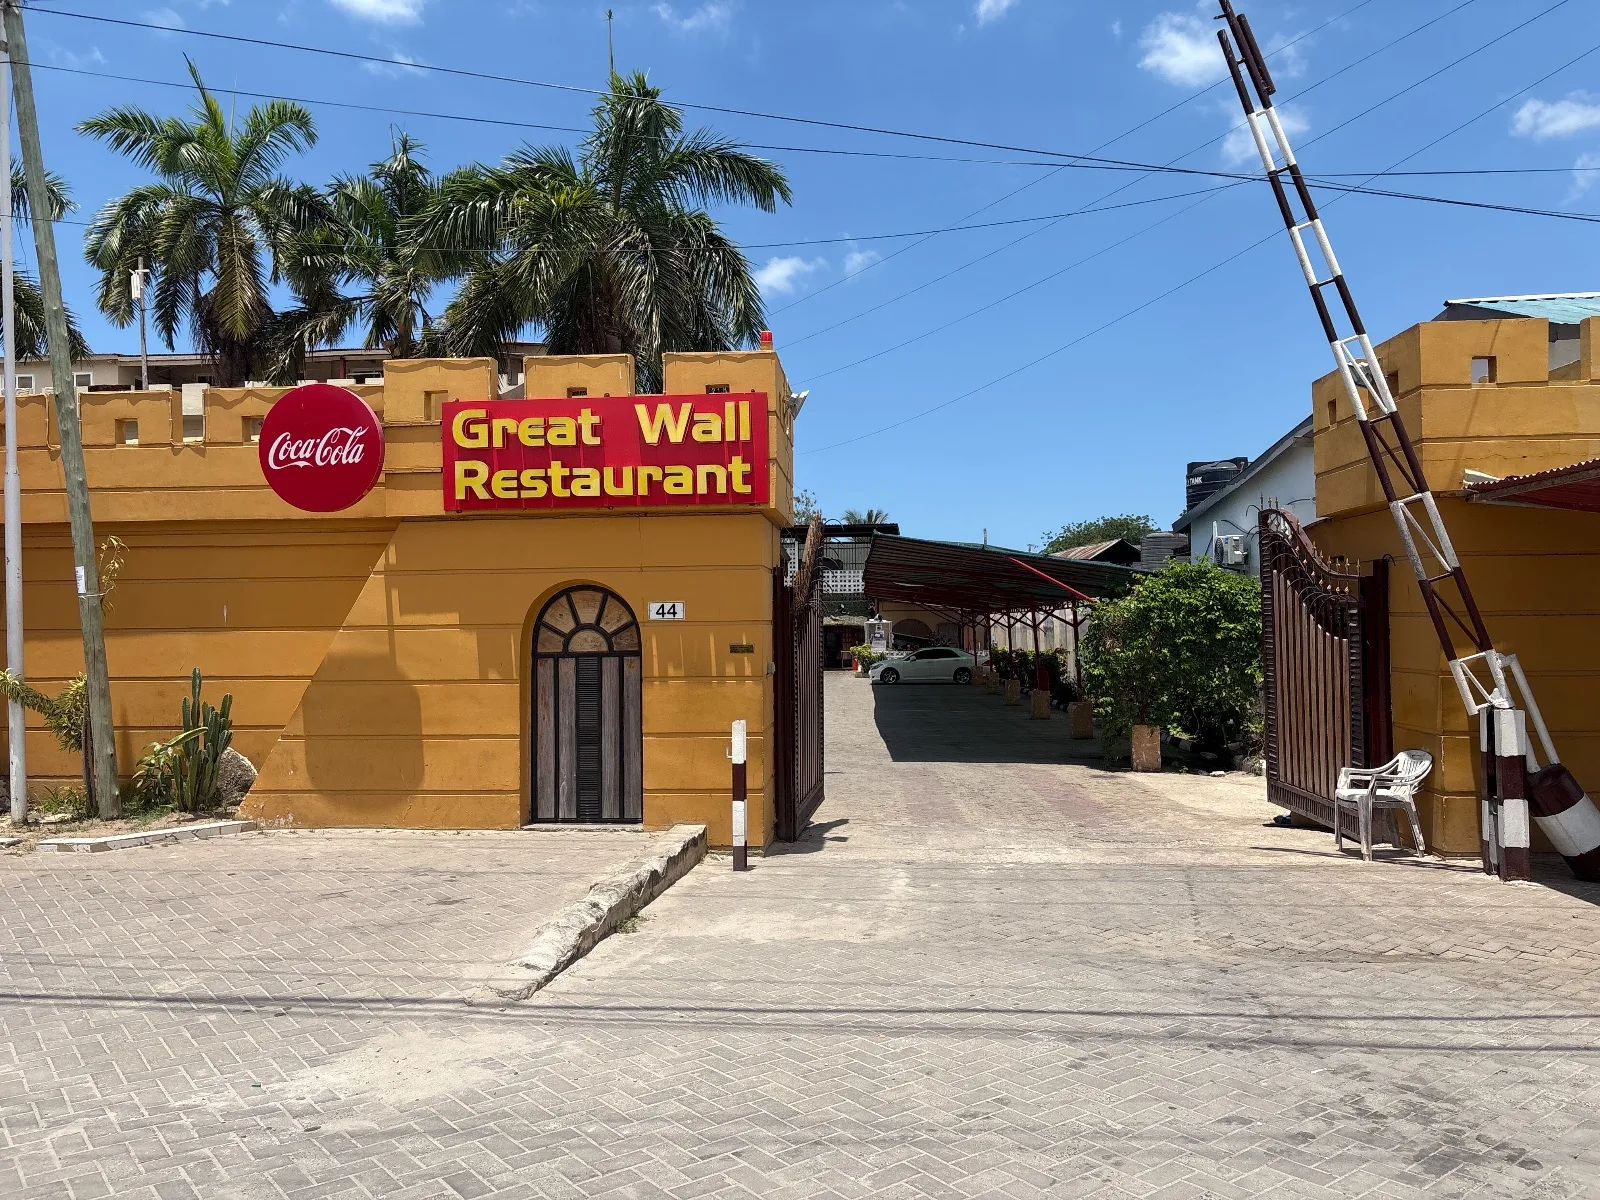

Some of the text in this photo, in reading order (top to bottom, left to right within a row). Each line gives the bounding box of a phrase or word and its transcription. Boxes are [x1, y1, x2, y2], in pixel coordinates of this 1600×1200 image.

[451, 400, 752, 449] Great Wall
[268, 426, 370, 470] Coca-Cola
[454, 455, 752, 500] Restaurant
[655, 603, 678, 618] 44
